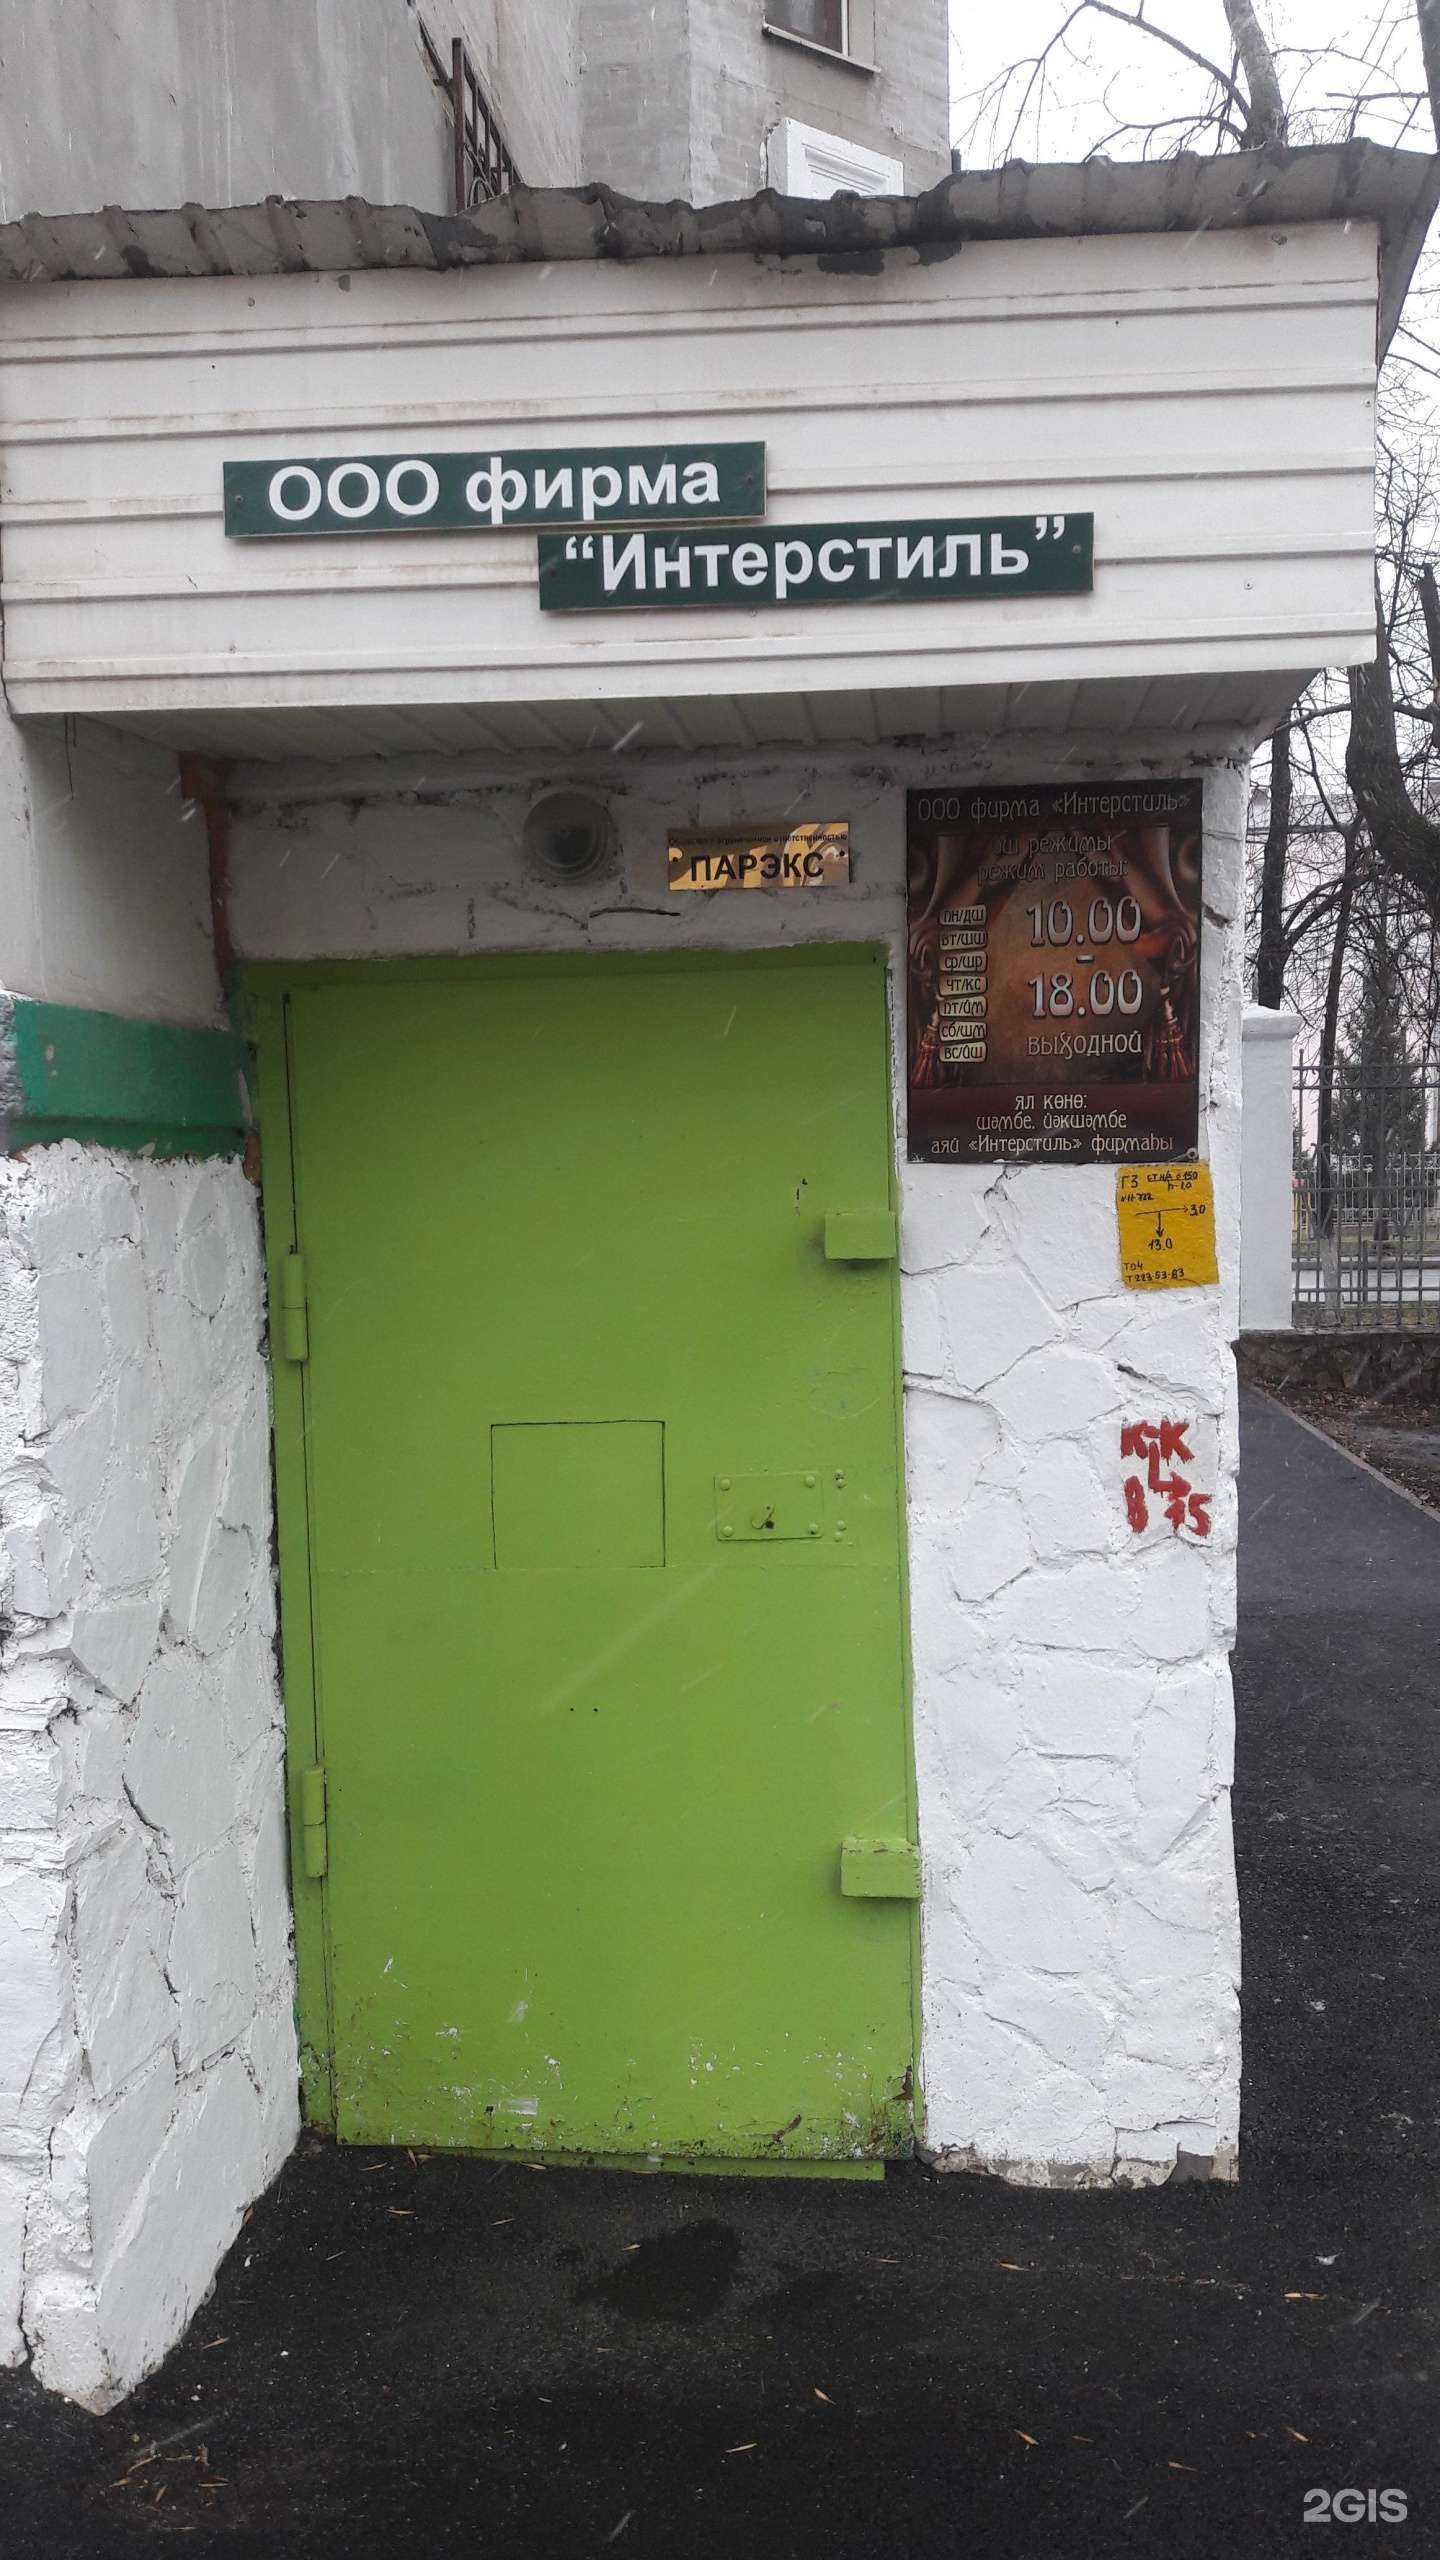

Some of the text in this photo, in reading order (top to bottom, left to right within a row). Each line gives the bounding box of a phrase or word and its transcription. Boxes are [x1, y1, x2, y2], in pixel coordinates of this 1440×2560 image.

[269, 456, 721, 524] ООО фирма
[918, 792, 1190, 823] ООО фирма «Интерстиль»
[1029, 835, 1111, 858] режимы
[690, 851, 824, 882] ПАРЭКС
[978, 862, 1046, 887] режим
[1028, 896, 1141, 946] 10.00
[1028, 969, 1143, 1018] 18.00
[968, 1134, 1082, 1158] «Интерстиль»
